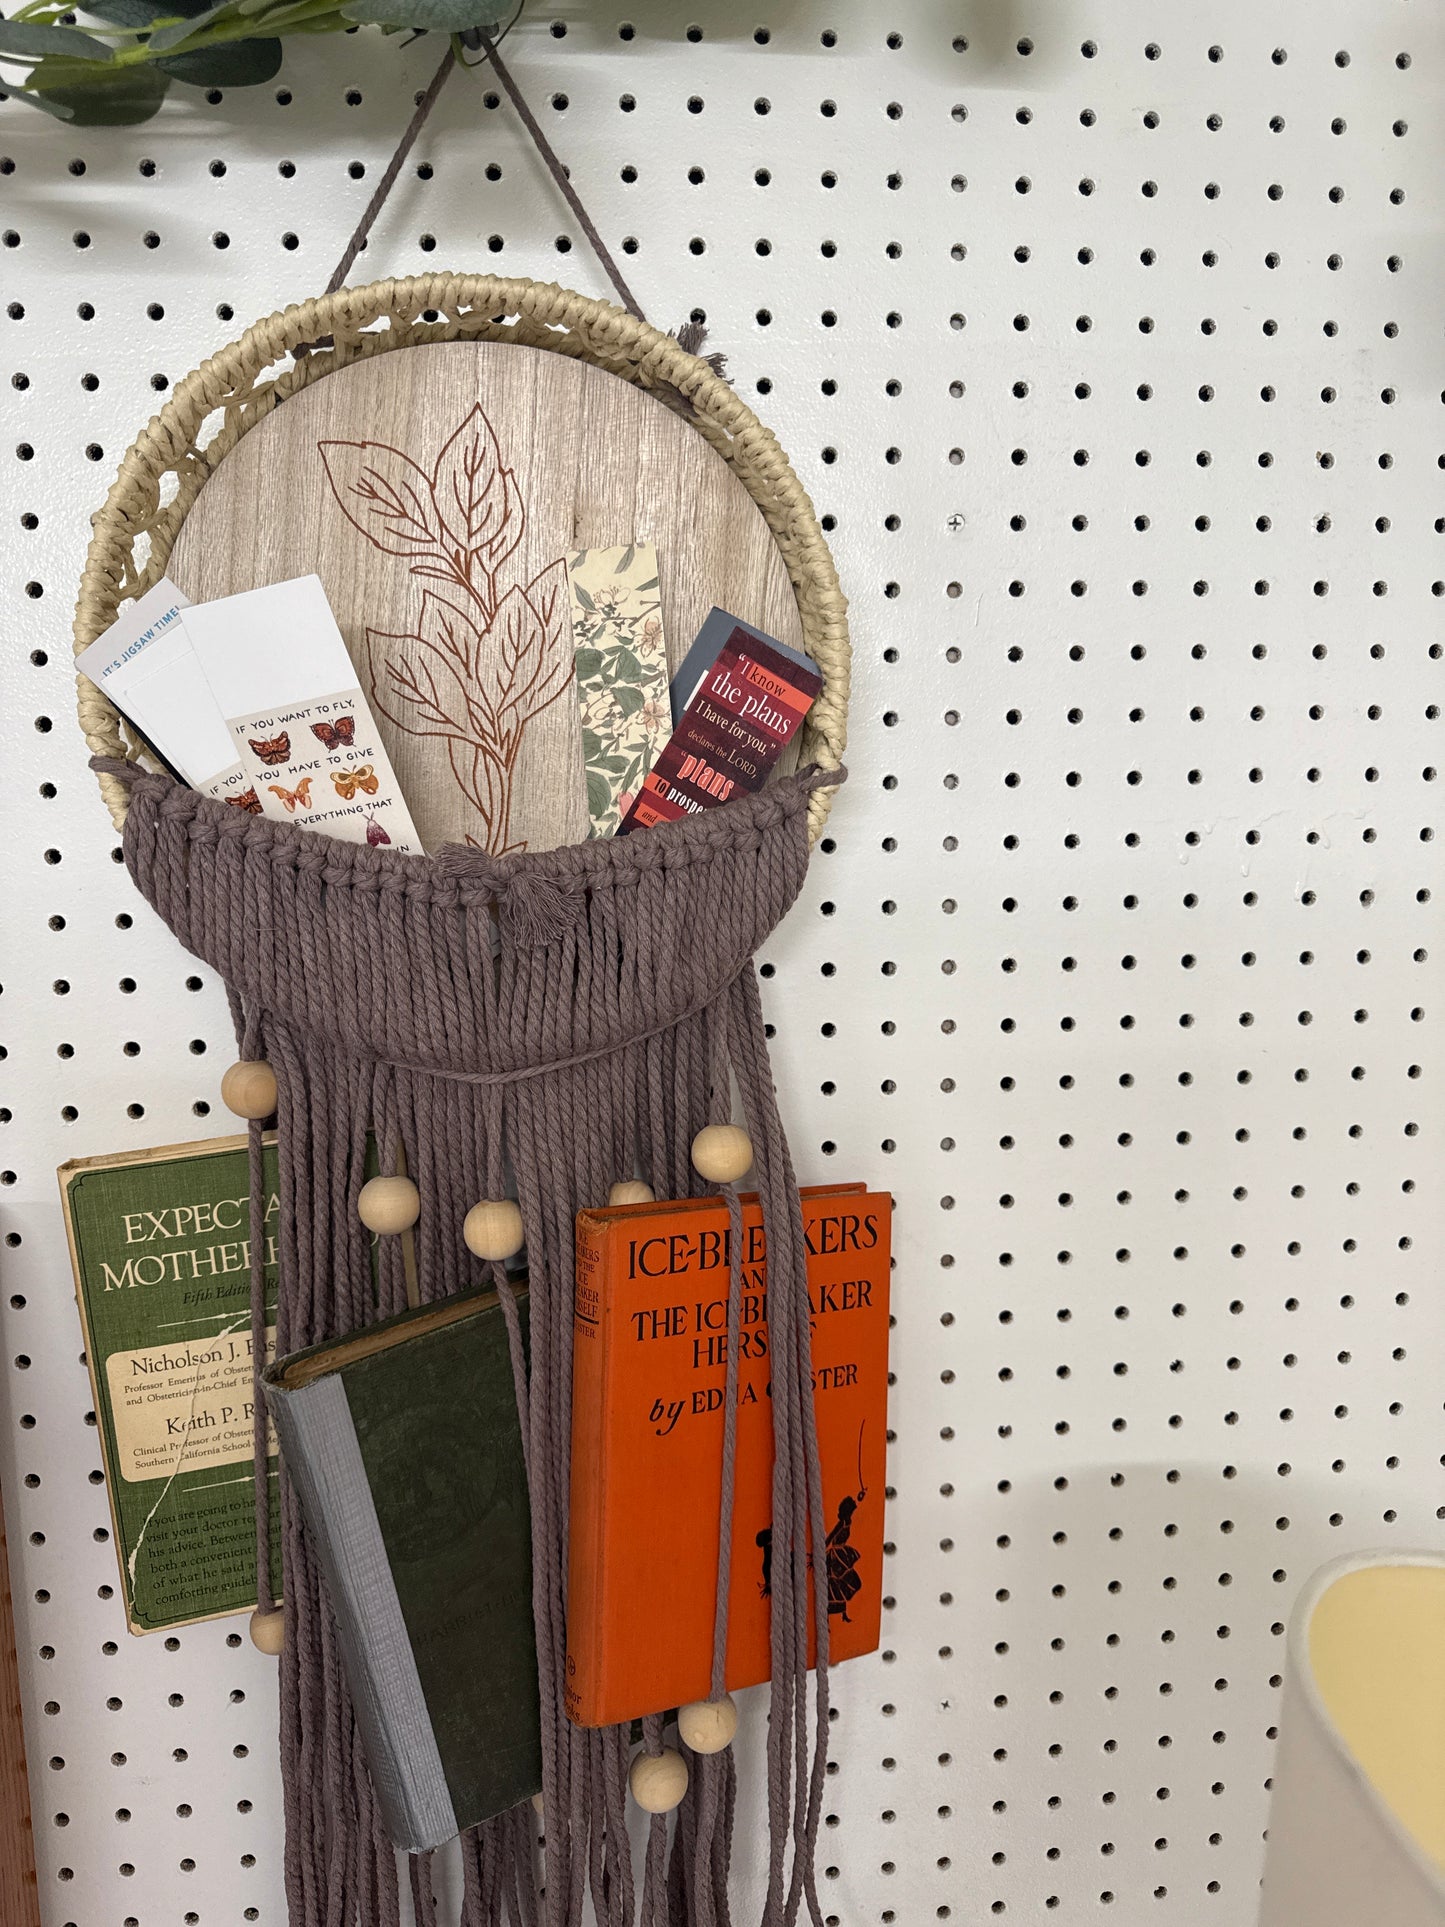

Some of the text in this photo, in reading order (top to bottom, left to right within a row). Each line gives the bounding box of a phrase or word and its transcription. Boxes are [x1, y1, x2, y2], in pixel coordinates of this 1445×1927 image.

[102, 605, 180, 677] IT'S JIGSAW TIME!
[749, 667, 786, 697] know
[236, 699, 355, 736] IF YOU WANT TO FLY,
[711, 672, 792, 735] the plans
[696, 699, 705, 713] I
[703, 705, 727, 730] have
[728, 721, 747, 739] for
[688, 730, 716, 752] declares
[715, 746, 728, 758] the
[256, 747, 374, 782] YOU HAVE TO GIVE
[210, 772, 243, 796] IF YOU
[654, 779, 706, 815] to prospe
[294, 798, 392, 827] EVERYTHING THAT
[641, 810, 656, 823] and
[628, 1214, 878, 1279] ICE-BEKERS
[739, 1268, 766, 1290] AN
[183, 1287, 212, 1306] Fifth
[216, 1283, 250, 1299] Editio
[631, 1306, 688, 1341] THE
[130, 1348, 223, 1376] Nicholson
[229, 1343, 240, 1363] J.
[124, 1381, 163, 1393] Professor
[168, 1374, 206, 1387] Emeritus
[210, 1369, 220, 1378] of
[126, 1396, 142, 1406] and
[147, 1378, 237, 1404] Obstetrician-in-Chief
[166, 1410, 216, 1435] Keith
[221, 1406, 237, 1425] P.
[649, 1398, 685, 1436] by
[133, 1444, 167, 1457] Clinical
[212, 1432, 221, 1441] of
[135, 1456, 174, 1470] Southern
[222, 1441, 251, 1453] School
[154, 1516, 176, 1528] you
[178, 1512, 194, 1522] are
[196, 1504, 228, 1518] going
[229, 1500, 241, 1510] to
[146, 1532, 170, 1543] visit
[172, 1525, 198, 1539] your
[202, 1517, 238, 1532] doctor
[148, 1547, 165, 1558] his
[168, 1541, 206, 1555] advice.
[150, 1559, 177, 1574] both
[190, 1547, 252, 1566] convenient
[153, 1577, 166, 1590] of
[169, 1571, 199, 1586] what
[202, 1567, 217, 1579] he
[221, 1562, 244, 1575] said
[155, 1582, 218, 1605] comforting
